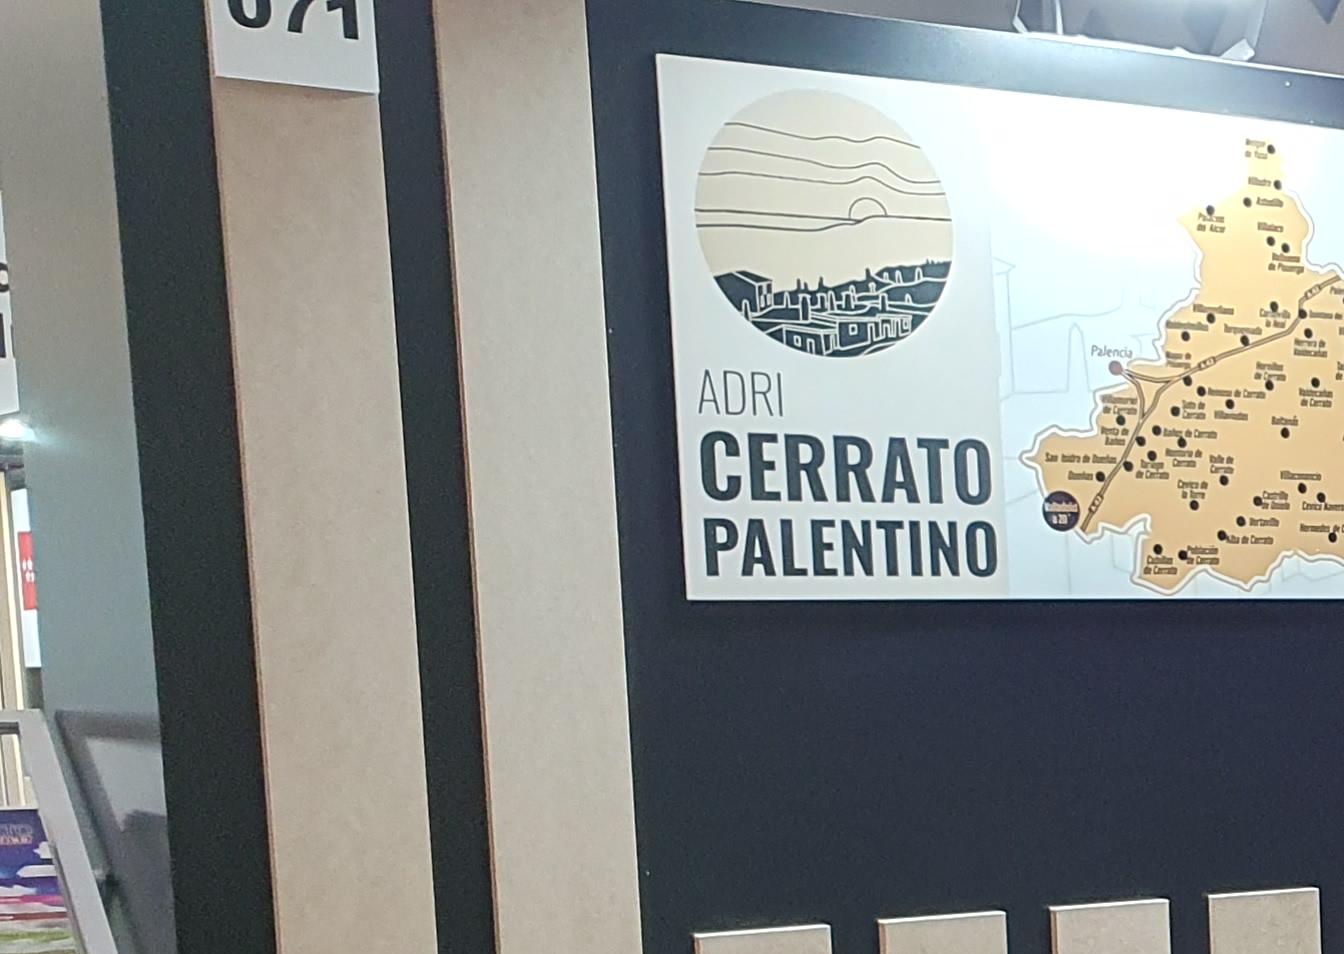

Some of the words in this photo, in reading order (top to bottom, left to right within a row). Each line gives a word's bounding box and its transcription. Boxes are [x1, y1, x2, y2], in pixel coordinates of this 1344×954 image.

[1091, 345, 1133, 359] Palencia
[699, 369, 784, 417] ADRI
[700, 430, 991, 505] CERRATO
[704, 518, 998, 578] PALENTINO
